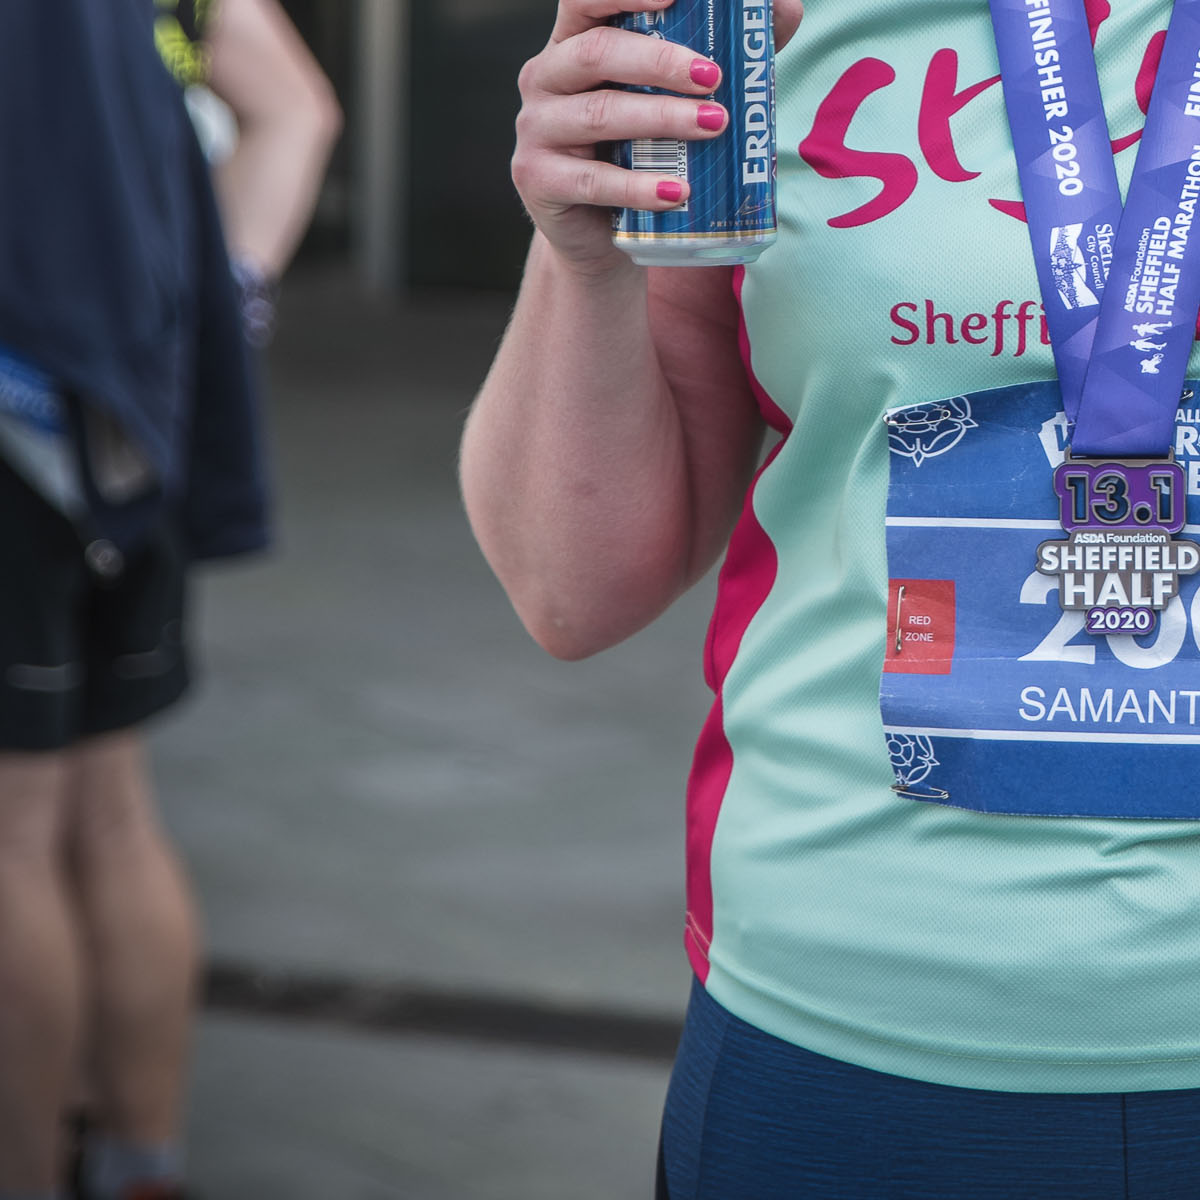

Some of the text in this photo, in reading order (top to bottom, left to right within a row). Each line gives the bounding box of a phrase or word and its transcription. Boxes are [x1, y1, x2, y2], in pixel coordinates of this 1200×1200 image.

[1048, 125, 1084, 196] 2020
[1086, 234, 1097, 254] City
[1090, 255, 1105, 289] Council
[1124, 227, 1150, 312] ASDA Foundation
[1135, 216, 1171, 315] SHEFFIELD
[1155, 264, 1181, 316] HALF
[890, 300, 1051, 357] Sheffi
[1064, 470, 1175, 524] 13.1
[1074, 533, 1167, 544] ASDA Foundation
[1040, 545, 1200, 571] SHEFFIELD
[1064, 572, 1174, 606] HALF
[905, 632, 934, 642] ZONE
[908, 615, 932, 625] RED
[1090, 611, 1150, 630] 2020
